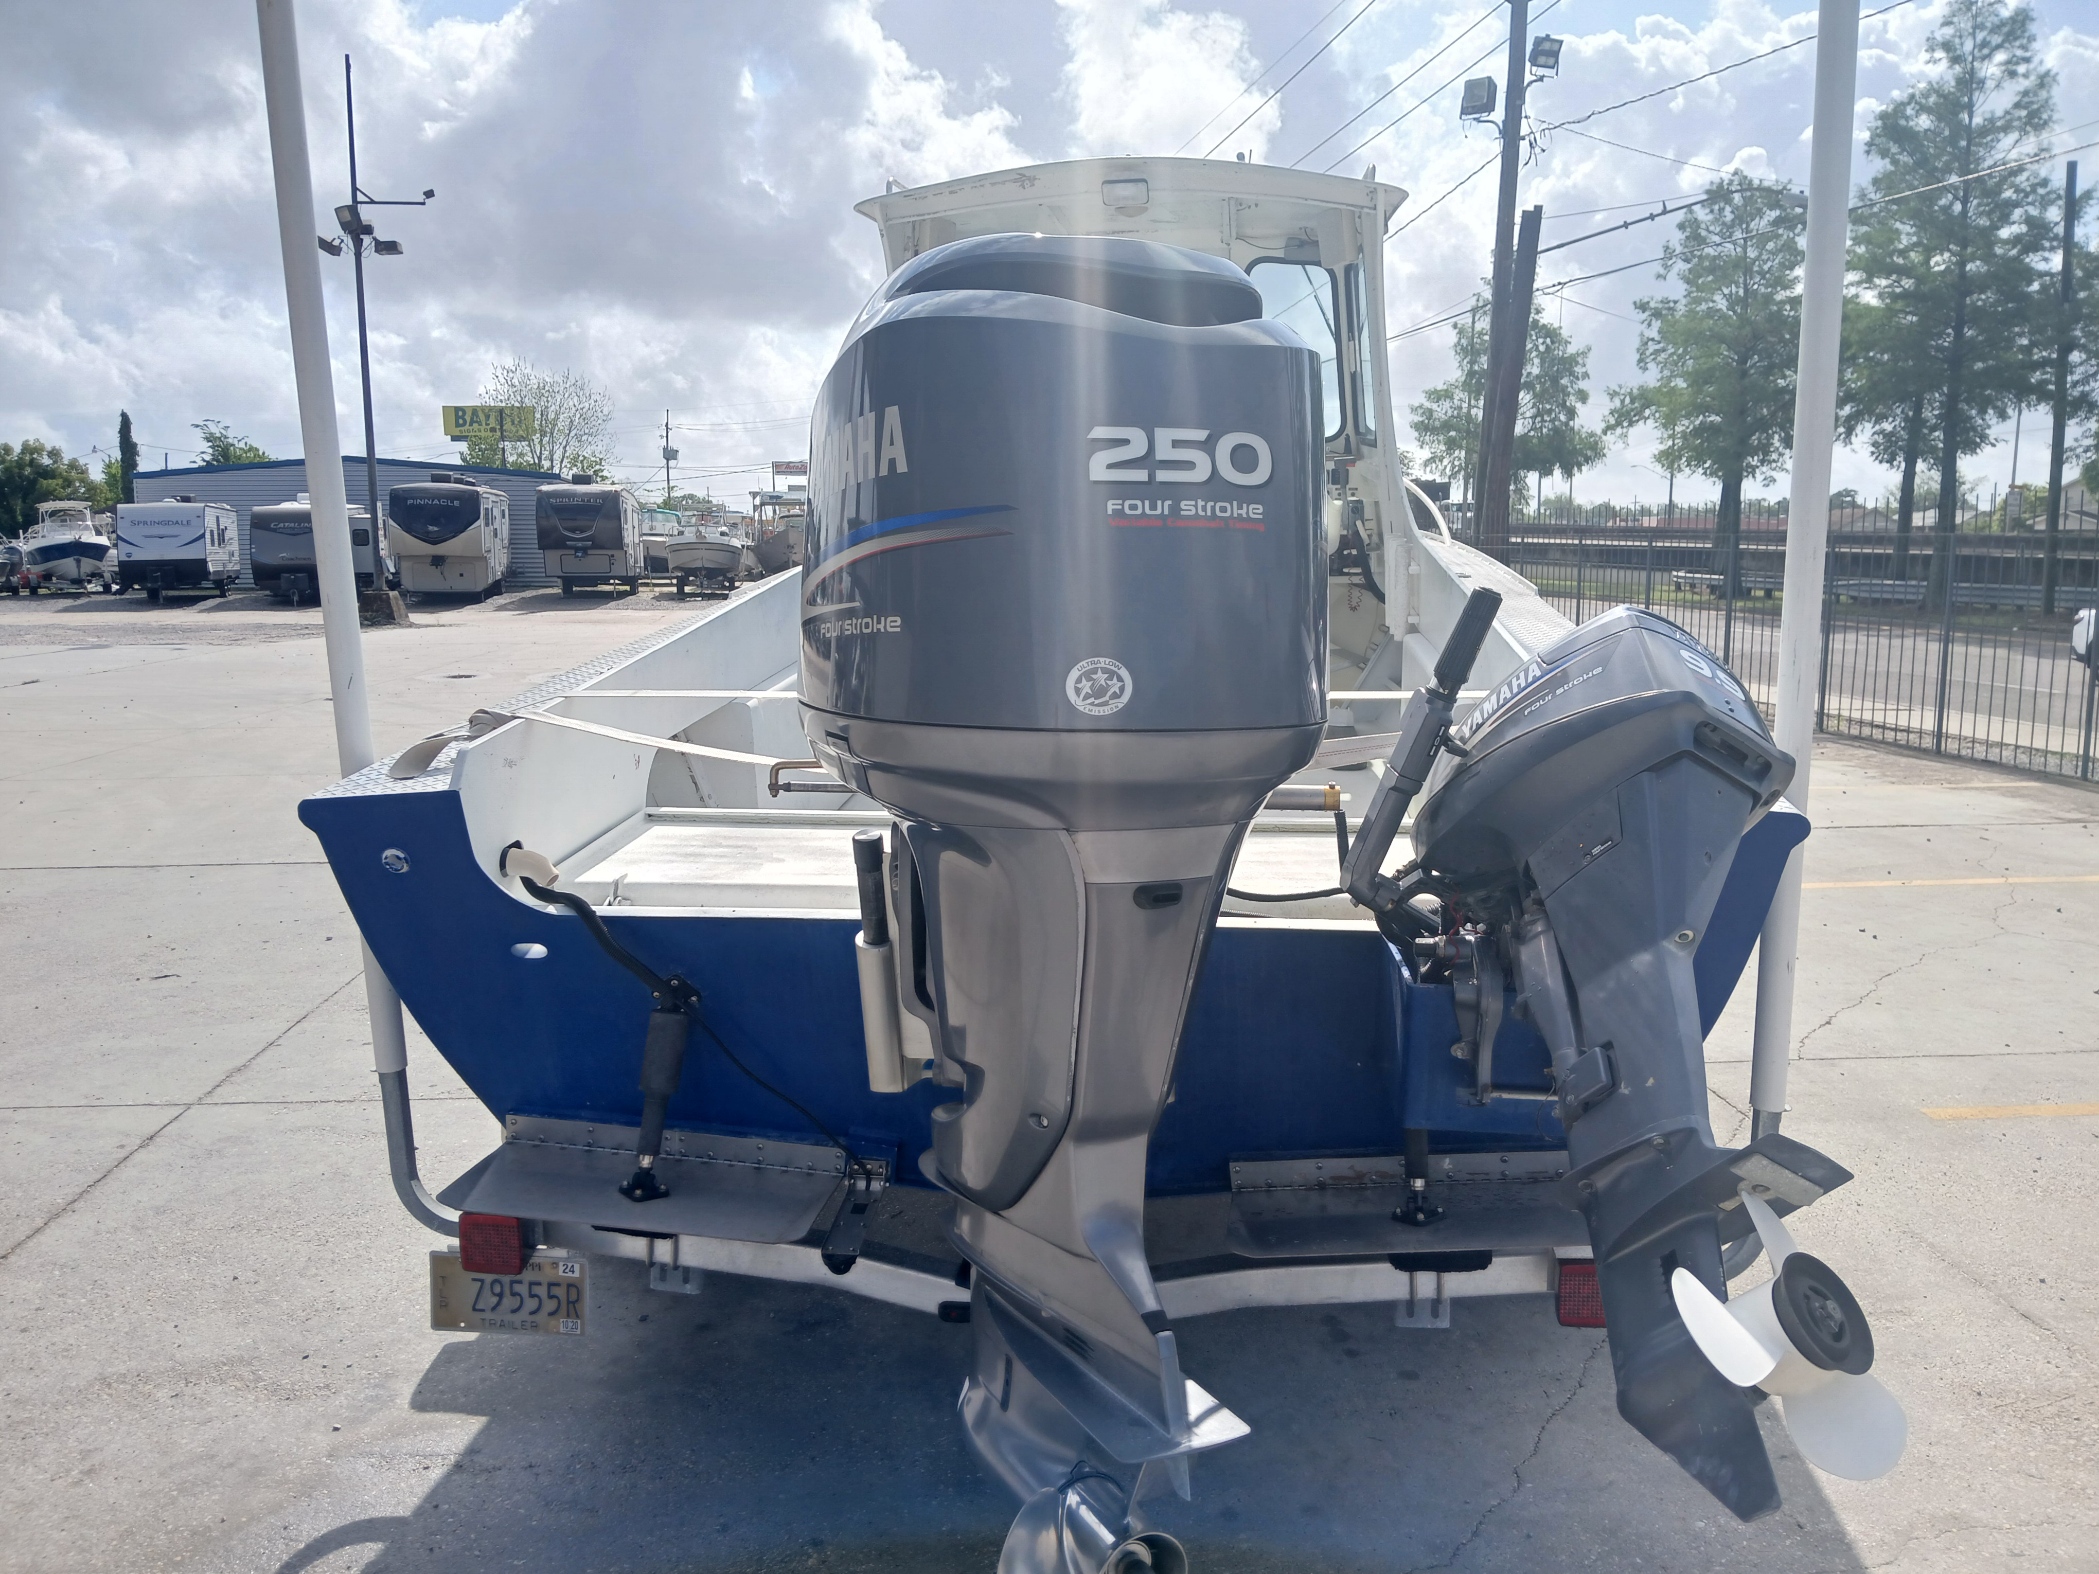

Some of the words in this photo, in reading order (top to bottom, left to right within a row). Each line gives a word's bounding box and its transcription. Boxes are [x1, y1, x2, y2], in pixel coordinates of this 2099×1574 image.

[1086, 426, 1273, 487] 250
[407, 499, 460, 507] PINNACLE
[1680, 649, 1746, 700] 9.9
[1083, 704, 1120, 714] EMISSION
[1462, 662, 1542, 738] YAMAHA
[562, 1263, 575, 1275] 24
[471, 1277, 580, 1319] Z9555R
[480, 1317, 539, 1331] TRAILER
